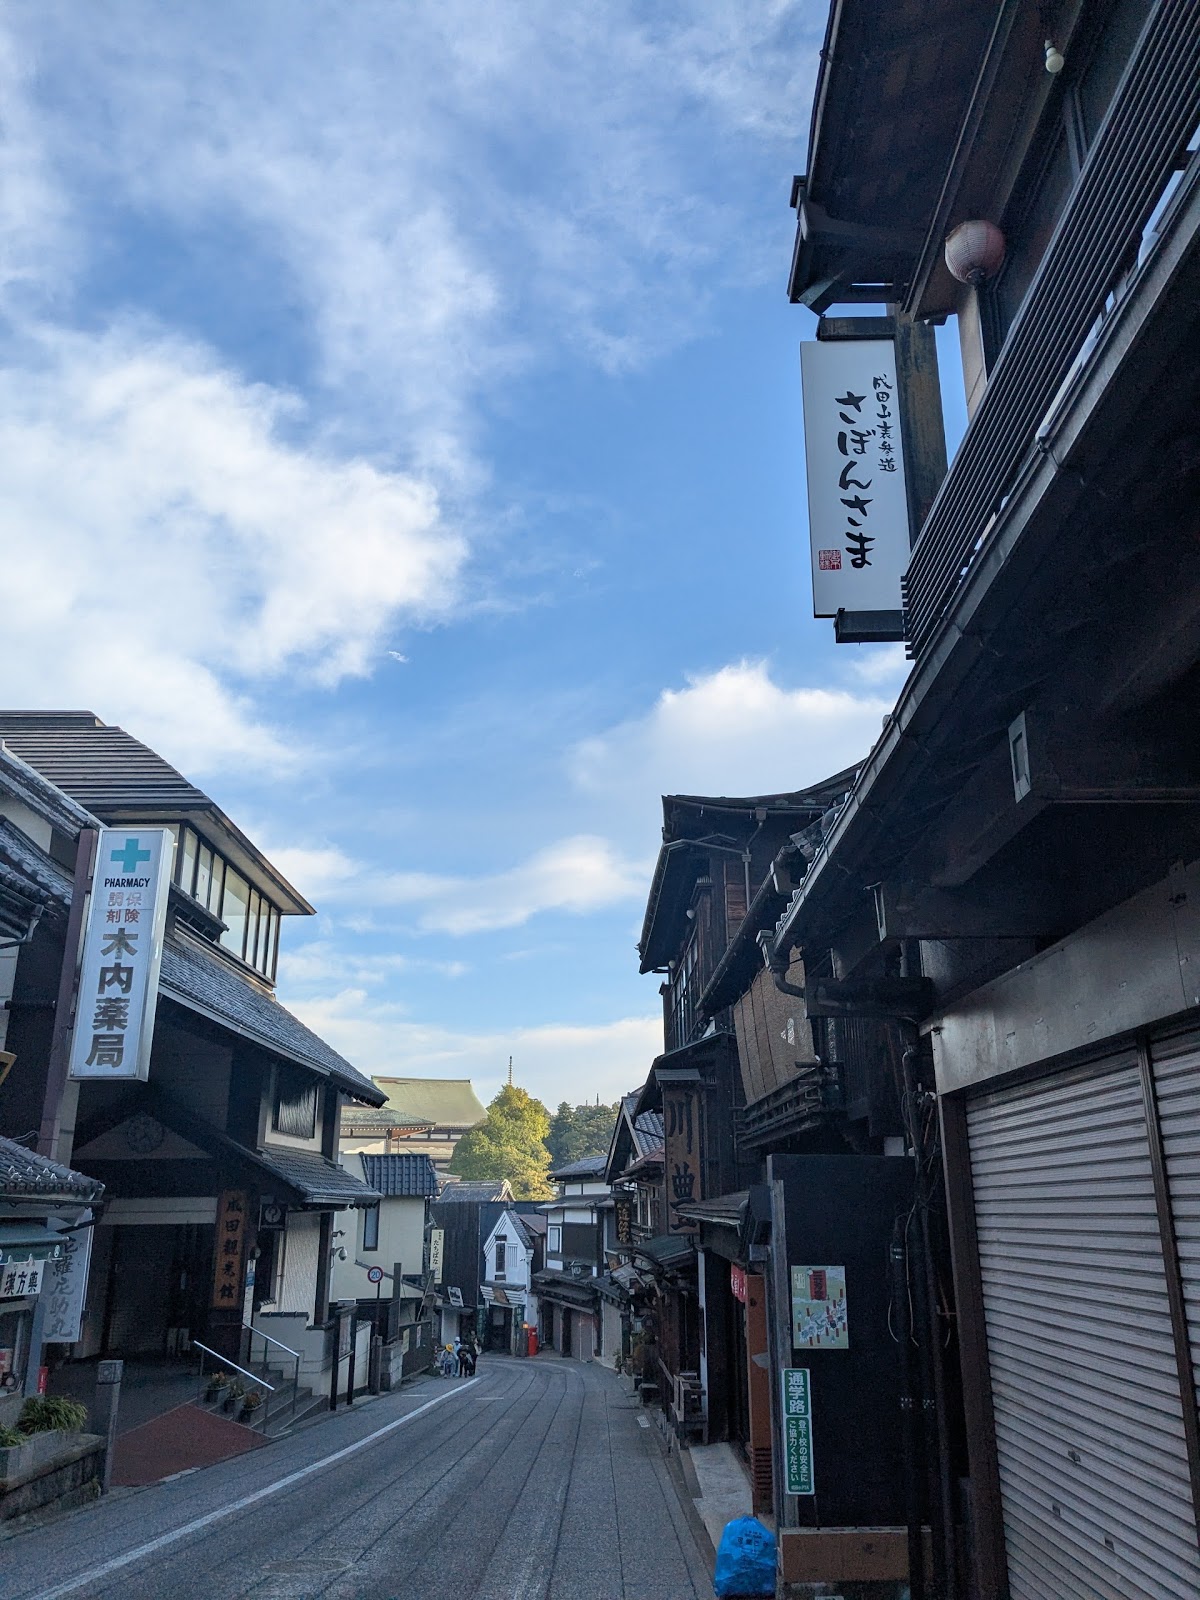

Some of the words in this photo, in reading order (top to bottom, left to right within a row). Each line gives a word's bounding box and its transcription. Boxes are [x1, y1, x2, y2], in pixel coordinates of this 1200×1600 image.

[835, 390, 877, 569] さぼんさま
[104, 877, 151, 888] PHARMACY
[85, 927, 139, 1068] 木内薬局
[370, 1270, 381, 1279] 20
[788, 1372, 805, 1413] 通学路
[789, 1420, 799, 1482] ご協力ください
[798, 1420, 809, 1482] 登下校の安全に
